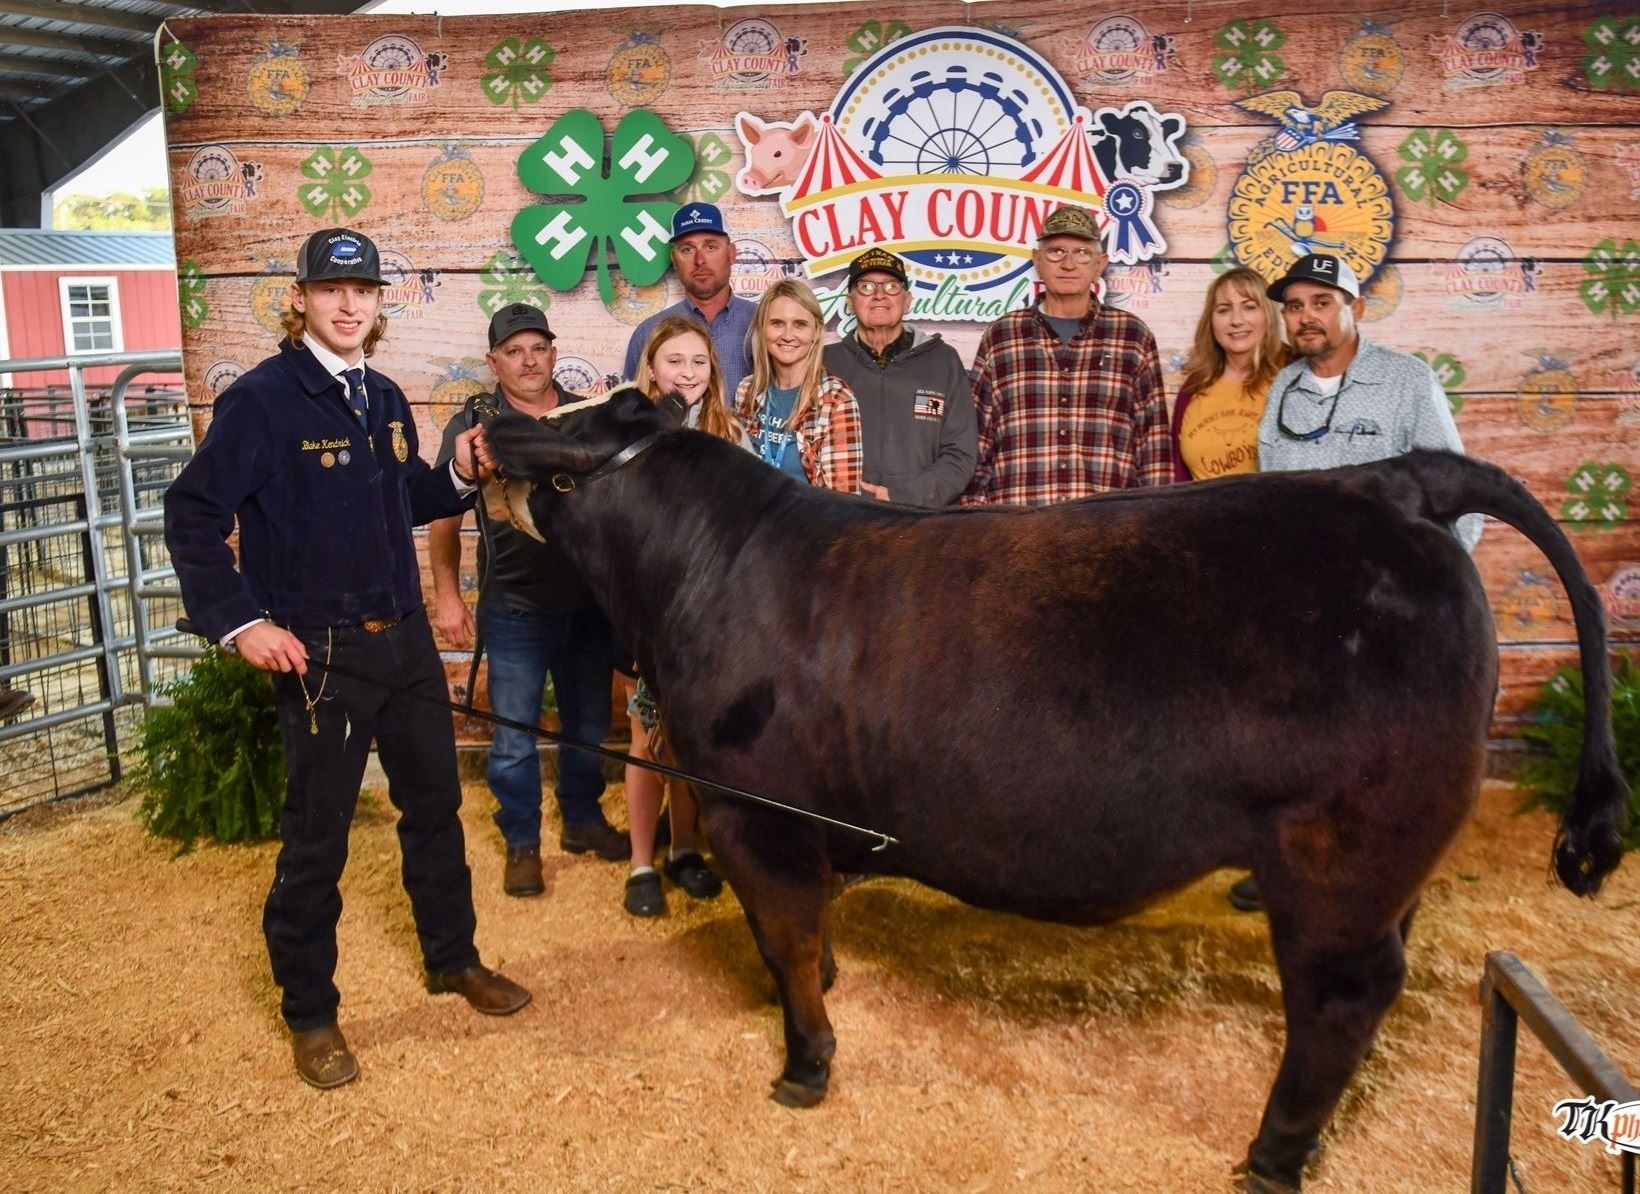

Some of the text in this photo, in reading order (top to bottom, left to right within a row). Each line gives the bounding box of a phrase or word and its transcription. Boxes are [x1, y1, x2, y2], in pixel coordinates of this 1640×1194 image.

[857, 30, 878, 50] H
[1224, 26, 1246, 47] H
[1254, 27, 1275, 47] H
[1594, 25, 1615, 46] H
[166, 50, 187, 71] H
[496, 46, 516, 65] H
[525, 45, 546, 64] H
[627, 58, 651, 69] FFA
[1077, 55, 1154, 73] CLAY COUNTY
[1444, 54, 1473, 71] CLAY
[267, 69, 290, 79] FFA
[712, 57, 788, 74] CLAY COUNTY
[1221, 57, 1243, 77] H
[1255, 57, 1277, 80] H
[1591, 56, 1613, 76] H
[352, 71, 429, 90] CLAY COUNTY
[489, 75, 510, 94] H
[523, 74, 544, 95] H
[768, 78, 786, 88] FAIR
[170, 81, 190, 103] H
[618, 133, 669, 184] H
[702, 142, 722, 163] H
[1407, 138, 1428, 159] H
[1437, 139, 1459, 160] H
[310, 155, 333, 177] H
[342, 155, 363, 177] H
[543, 135, 596, 187] H
[441, 173, 465, 183] FFA
[702, 173, 723, 194] H
[1254, 160, 1367, 209] AGRICULTURAL
[1404, 169, 1426, 190] H
[1438, 171, 1460, 192] H
[183, 183, 246, 203] CLAY COUNTY
[307, 186, 329, 207] H
[342, 187, 363, 208] H
[1281, 181, 1344, 205] FFA
[229, 203, 246, 213] FAIR
[797, 188, 1111, 258] CLAY COUN
[328, 235, 341, 244] Clay
[535, 210, 587, 261] H
[620, 210, 672, 262] H
[330, 255, 363, 266] Cooperative
[1588, 282, 1609, 302] H
[406, 309, 424, 320] FAIR
[1575, 471, 1596, 492] H
[1602, 471, 1624, 492] H
[1569, 501, 1590, 521] H
[1601, 502, 1621, 521] H
